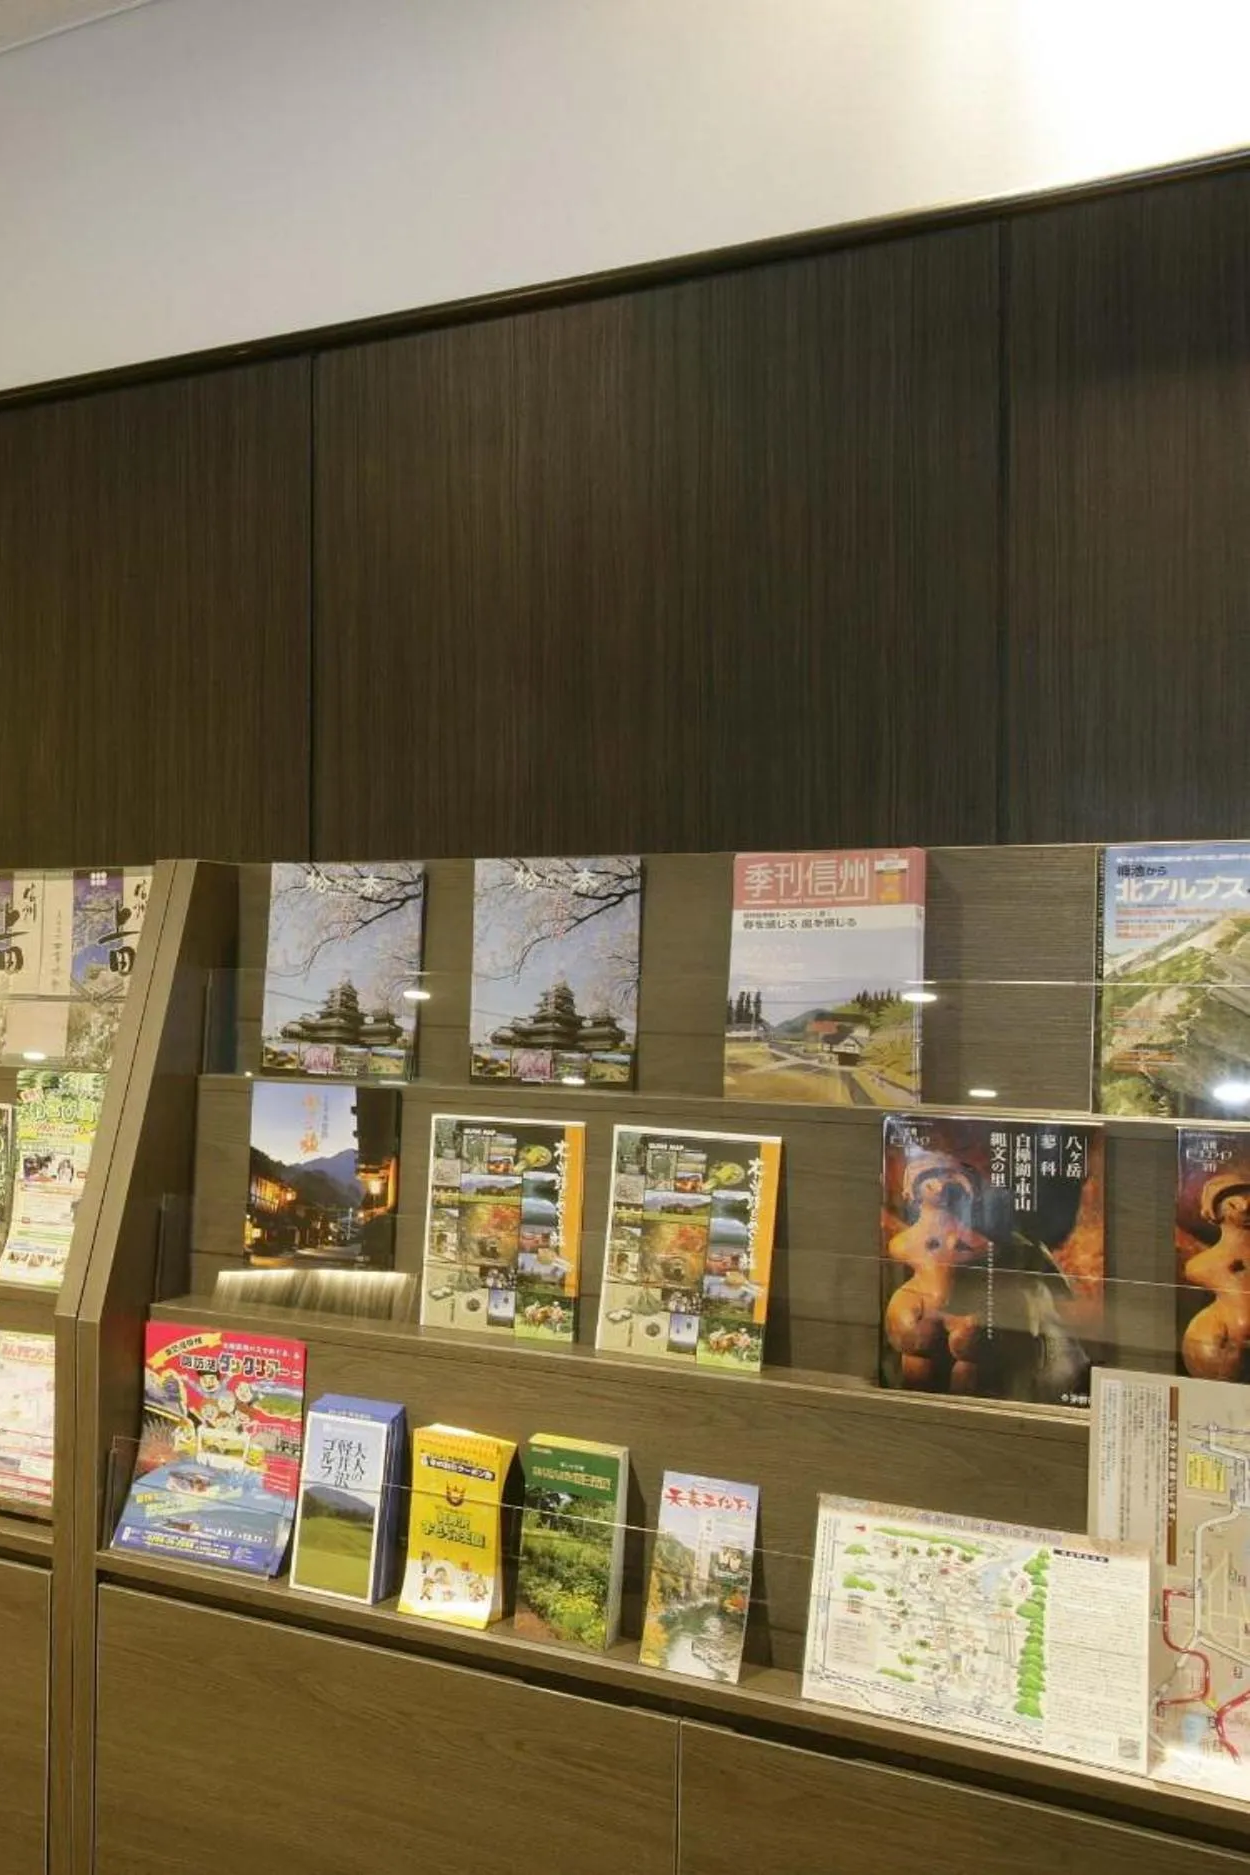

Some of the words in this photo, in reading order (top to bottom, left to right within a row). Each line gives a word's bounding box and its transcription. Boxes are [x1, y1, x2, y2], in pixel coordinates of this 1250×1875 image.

[744, 858, 869, 899] 季刊信州
[1115, 876, 1248, 902] 北アルプス
[990, 1131, 1006, 1188] 縄文の里
[1065, 1136, 1083, 1178] 八ヶ岳
